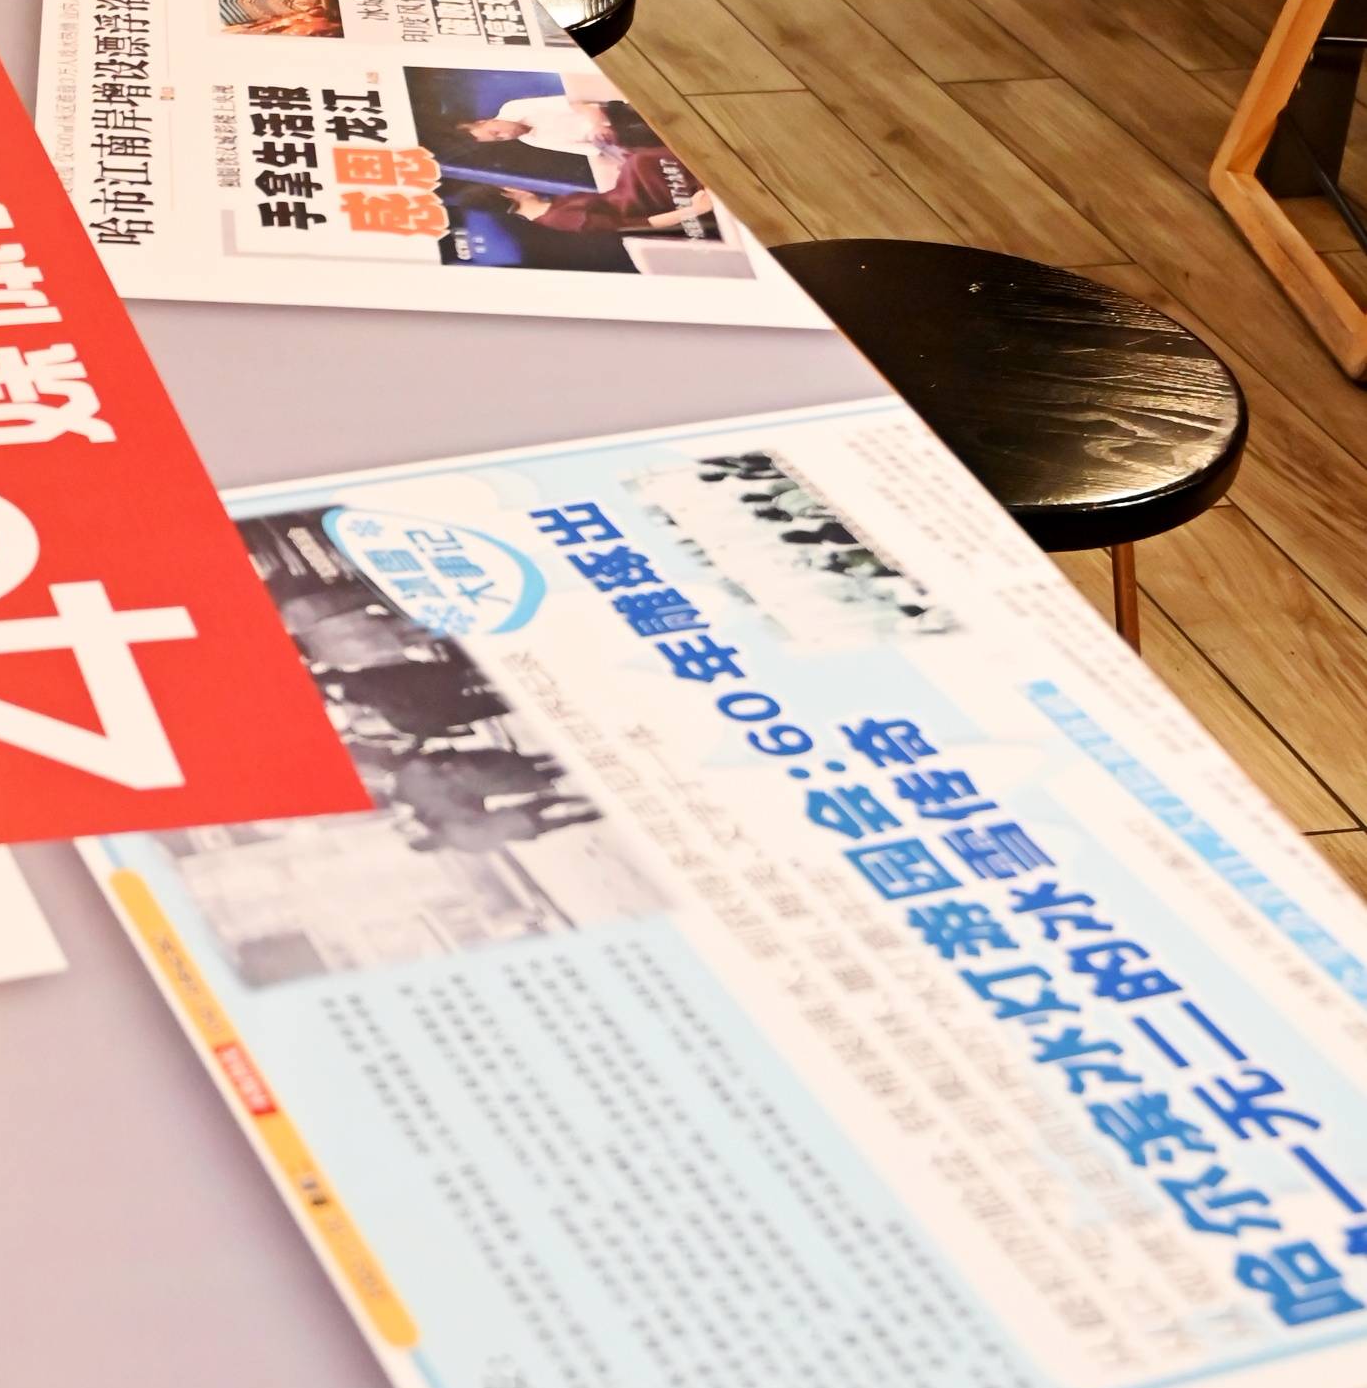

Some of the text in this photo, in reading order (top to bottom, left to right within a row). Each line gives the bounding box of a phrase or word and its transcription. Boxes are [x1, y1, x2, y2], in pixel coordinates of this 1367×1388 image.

[247, 84, 328, 231] 手拿生活报
[321, 88, 450, 238] 感恩 龙江
[411, 523, 498, 611] 大事记
[527, 498, 1367, 1328] 哈尔滨冰灯游园会:60年雕琢出
[839, 718, 1367, 1261] 一无二的冰雪传奇
